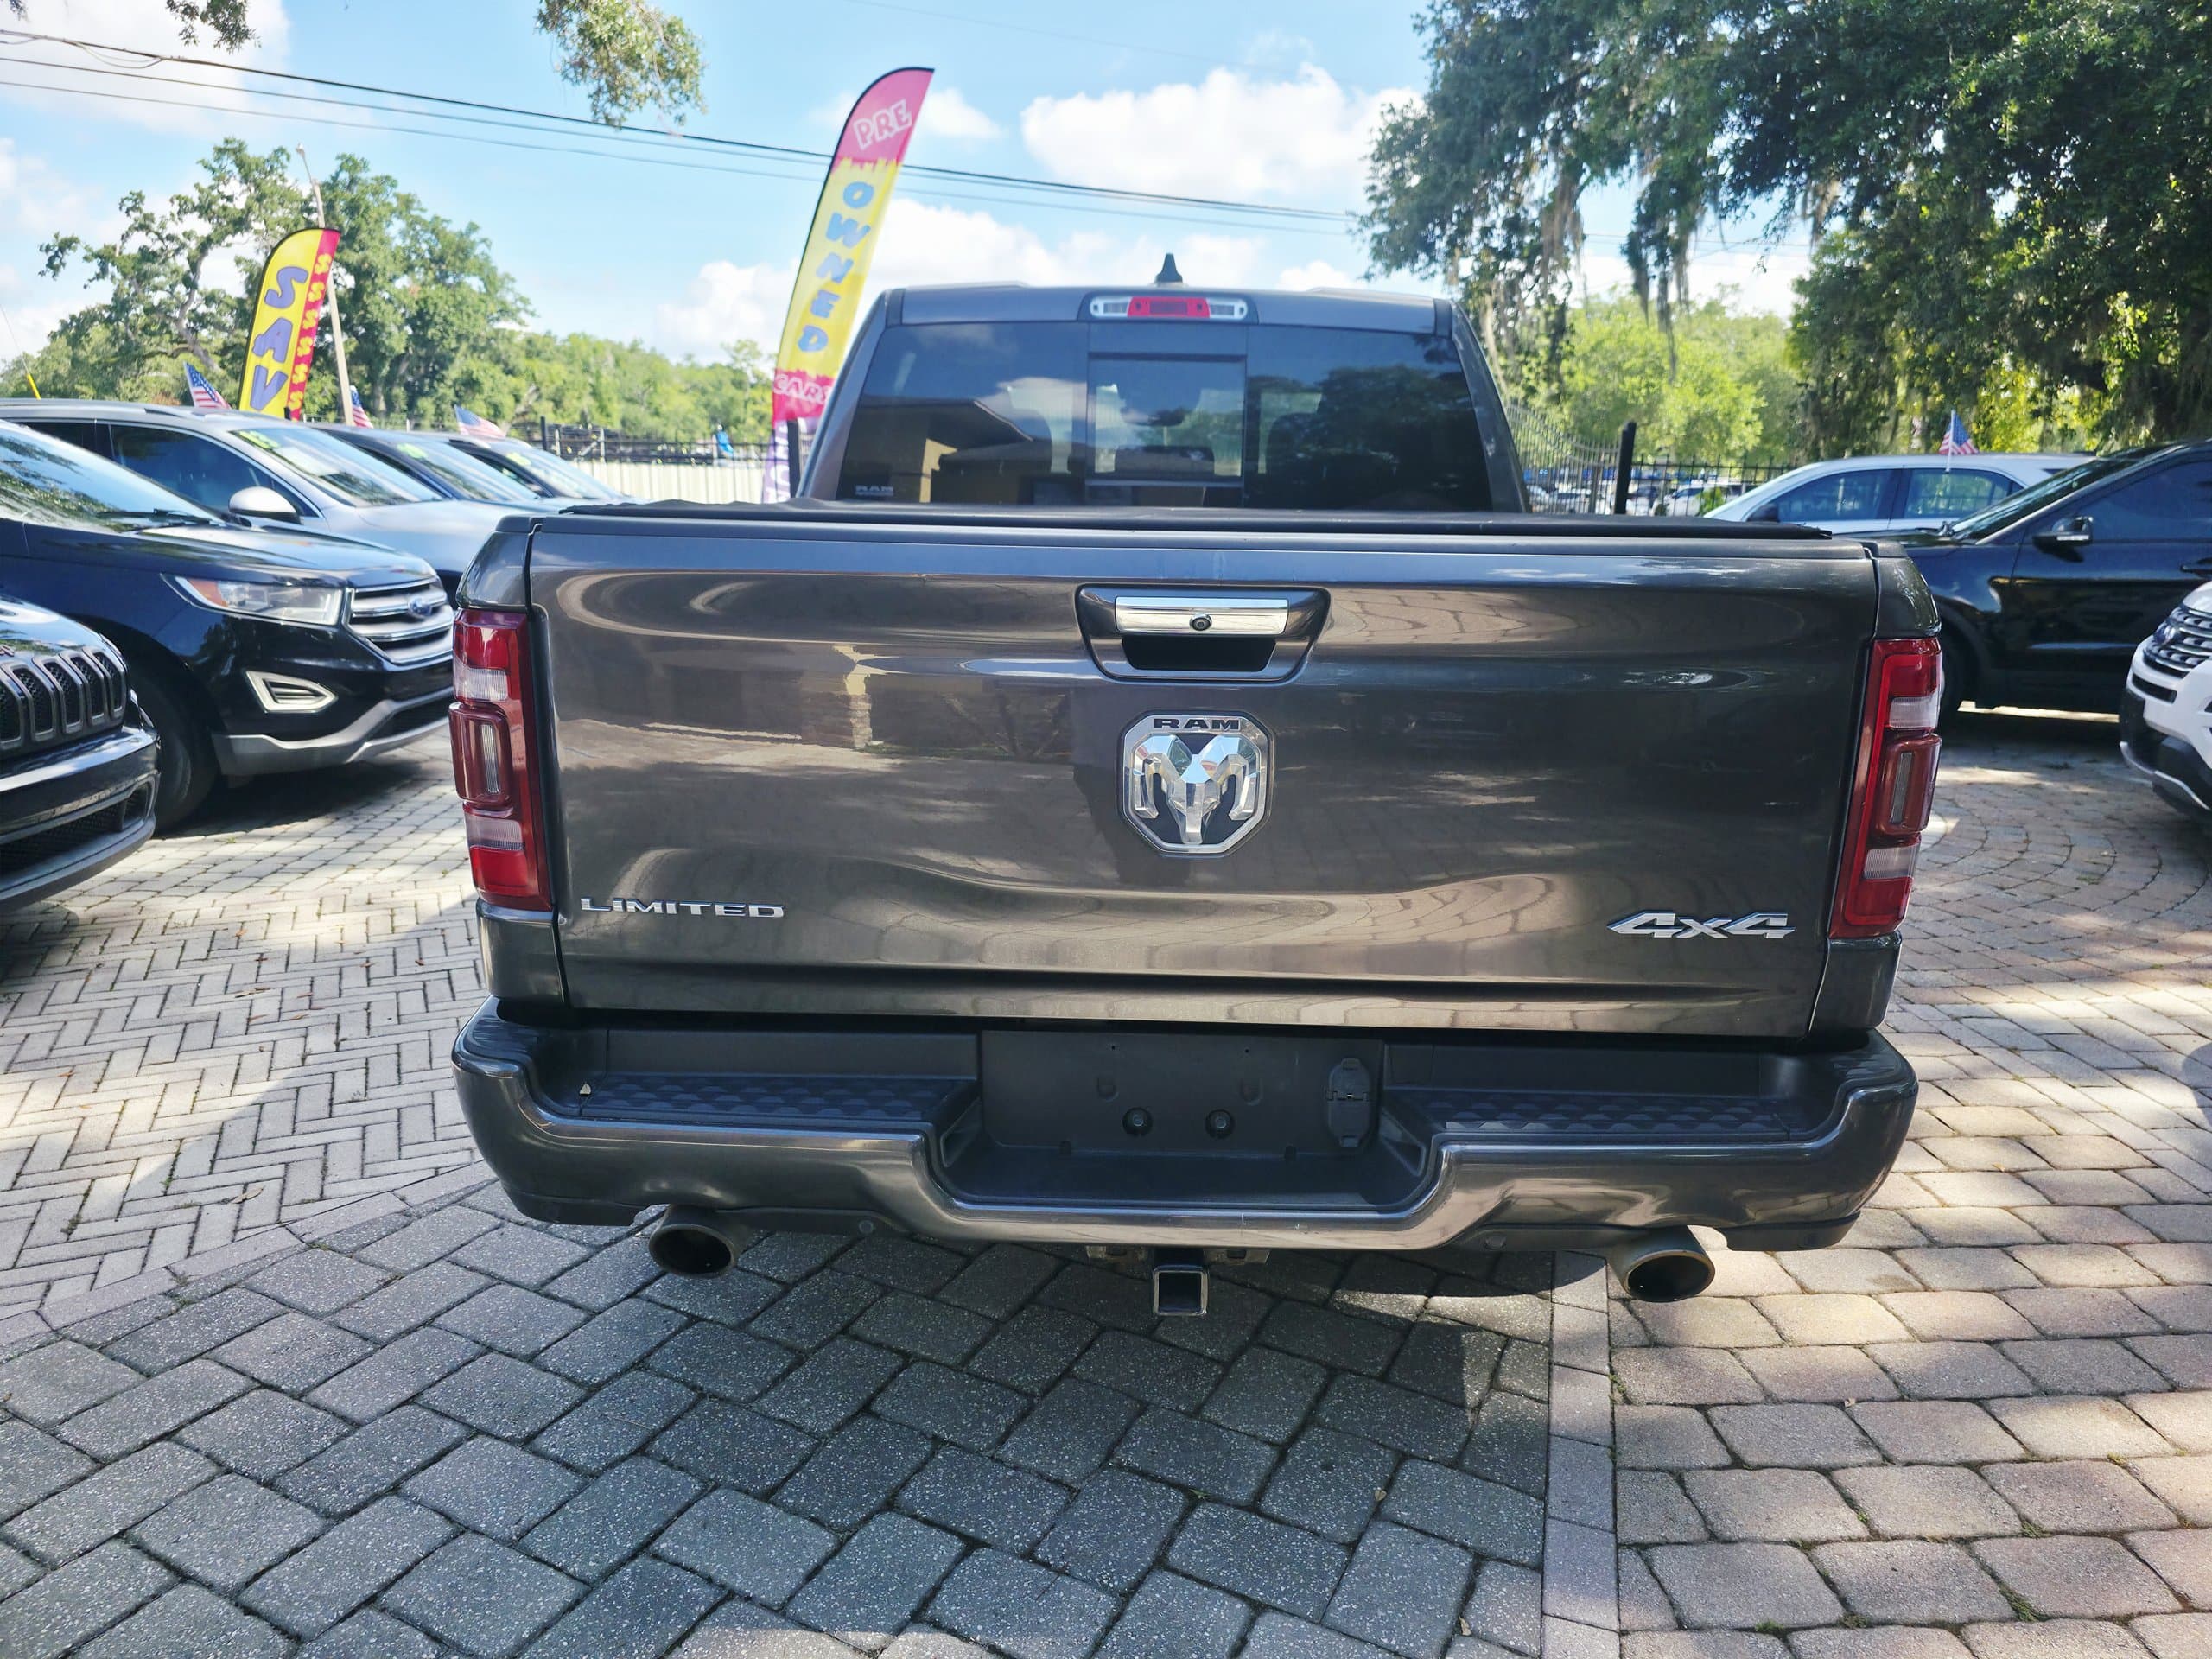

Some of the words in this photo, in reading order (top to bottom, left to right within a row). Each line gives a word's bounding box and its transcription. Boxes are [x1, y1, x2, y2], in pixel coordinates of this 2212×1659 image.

[853, 99, 913, 150] PRE
[798, 181, 874, 353] OWNED
[1153, 718, 1240, 729] RAM
[581, 897, 785, 918] LIMITED
